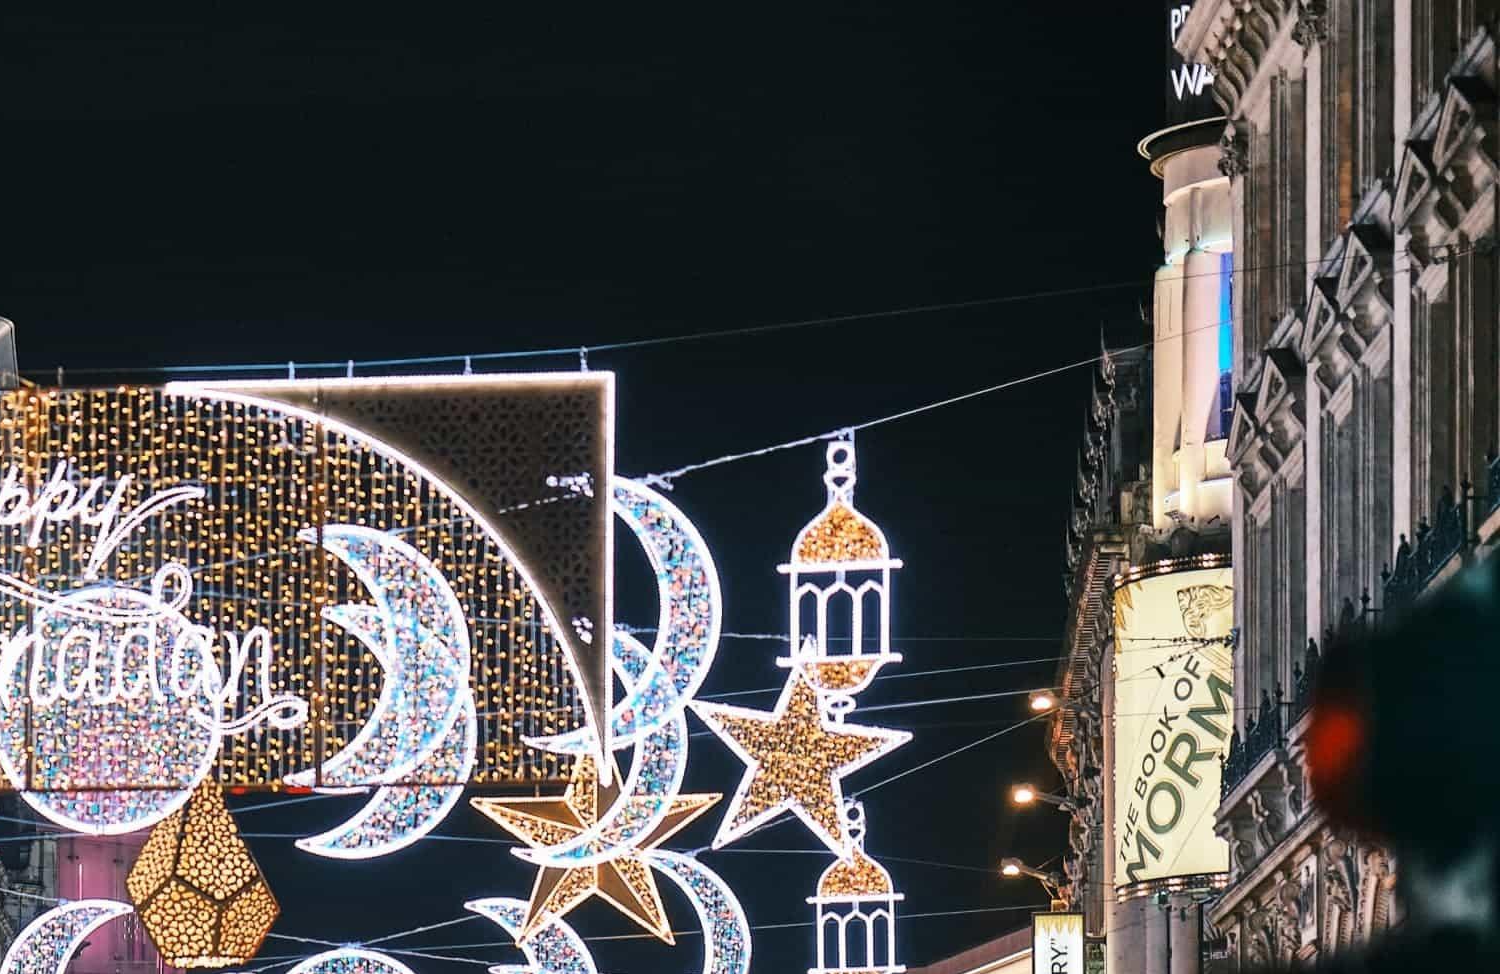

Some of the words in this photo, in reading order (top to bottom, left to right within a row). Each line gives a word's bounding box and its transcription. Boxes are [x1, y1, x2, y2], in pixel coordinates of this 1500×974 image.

[1120, 803, 1141, 861] THE
[1134, 704, 1181, 800] BOOK
[1174, 655, 1202, 702] OF
